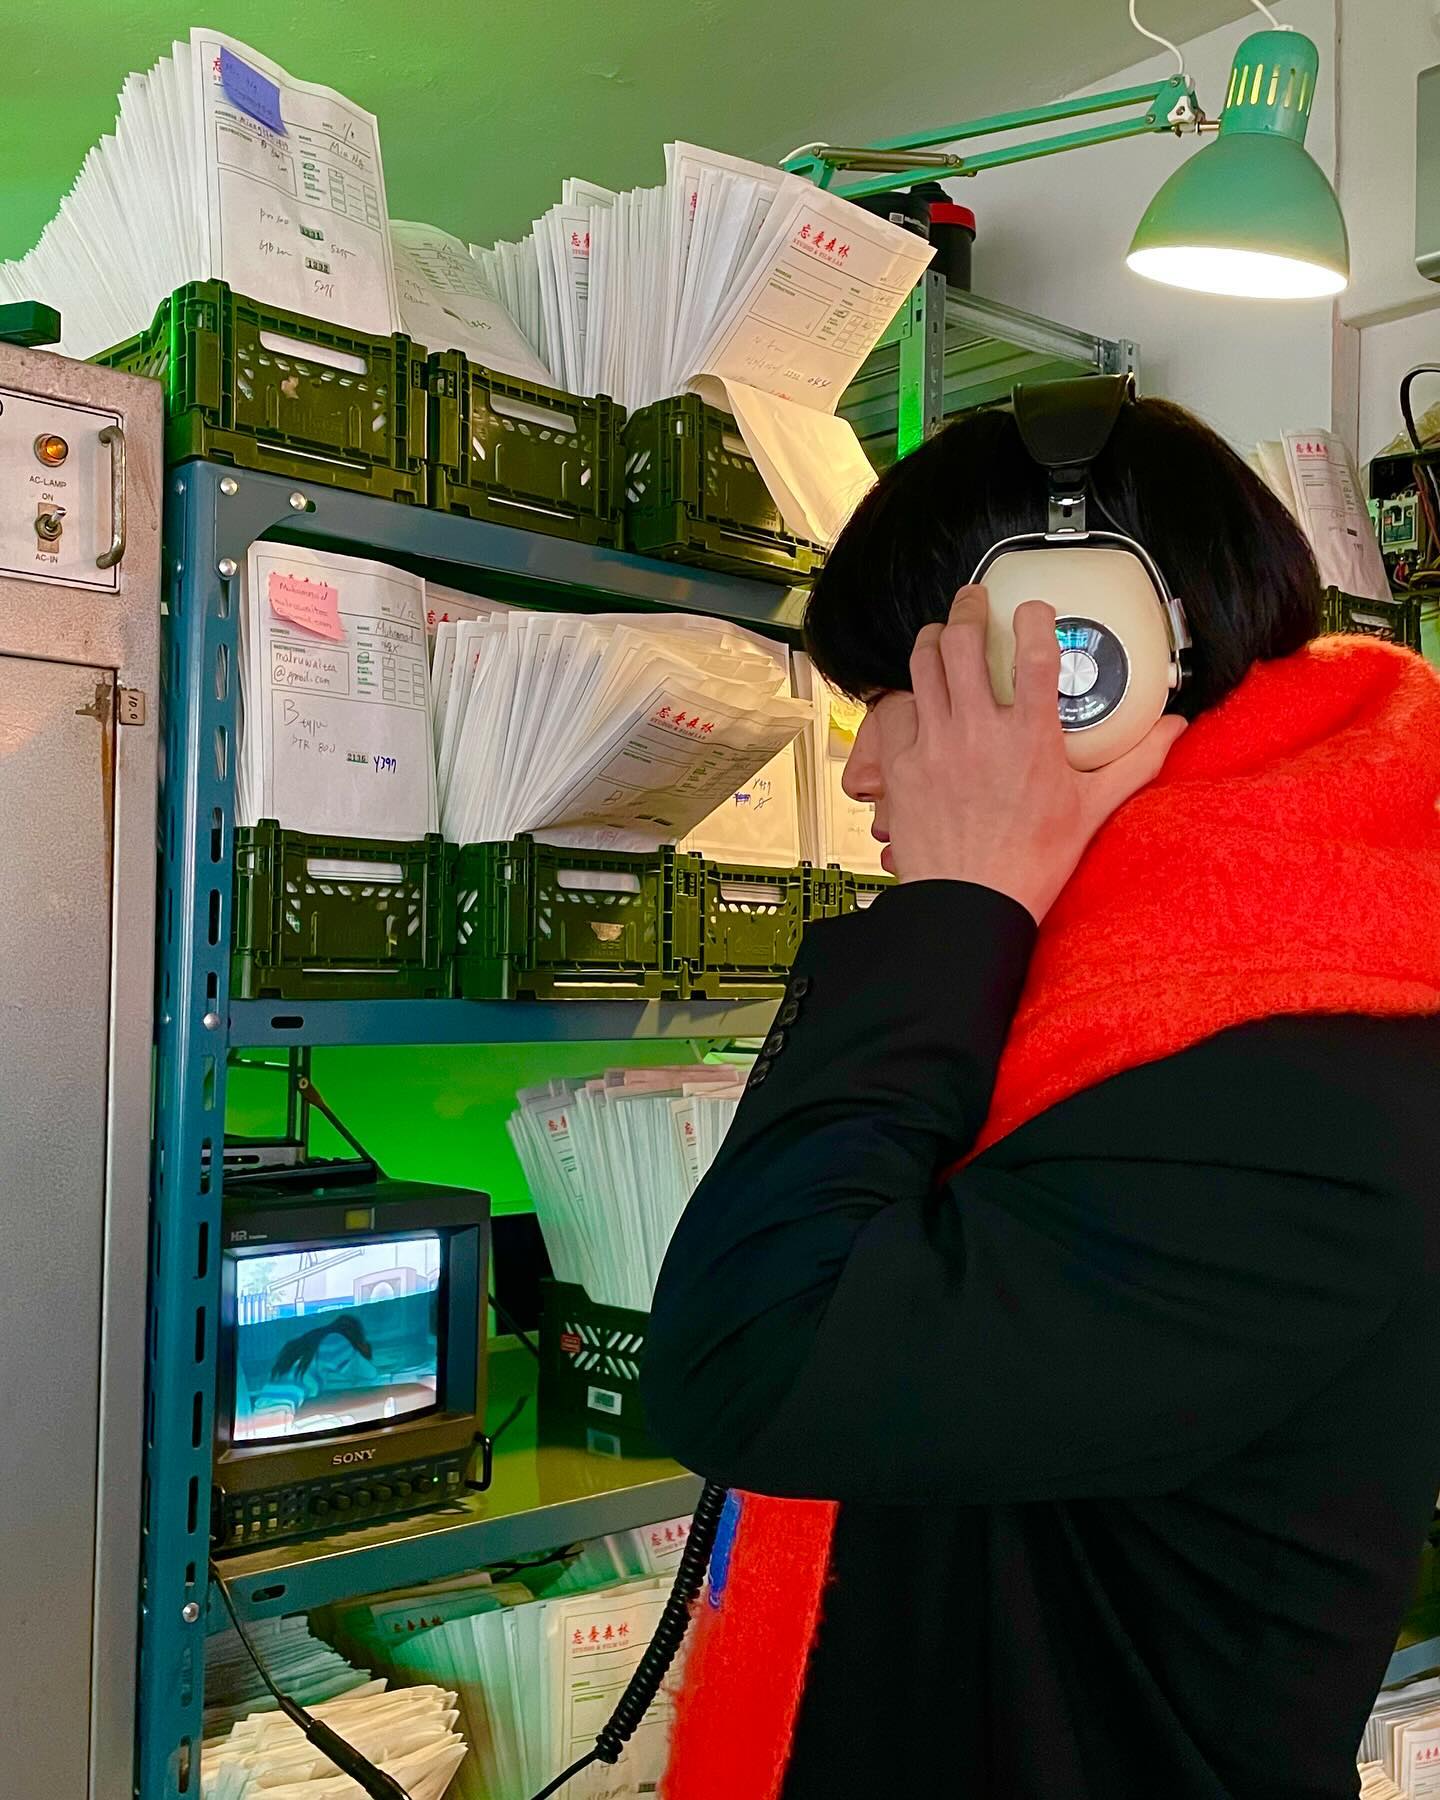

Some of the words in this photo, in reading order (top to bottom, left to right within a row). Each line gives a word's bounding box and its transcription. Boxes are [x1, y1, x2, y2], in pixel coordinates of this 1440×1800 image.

[29, 476, 67, 488] AC-LAMP
[42, 492, 54, 501] ON
[35, 553, 59, 564] AC-IN
[332, 1448, 376, 1465] SONY
